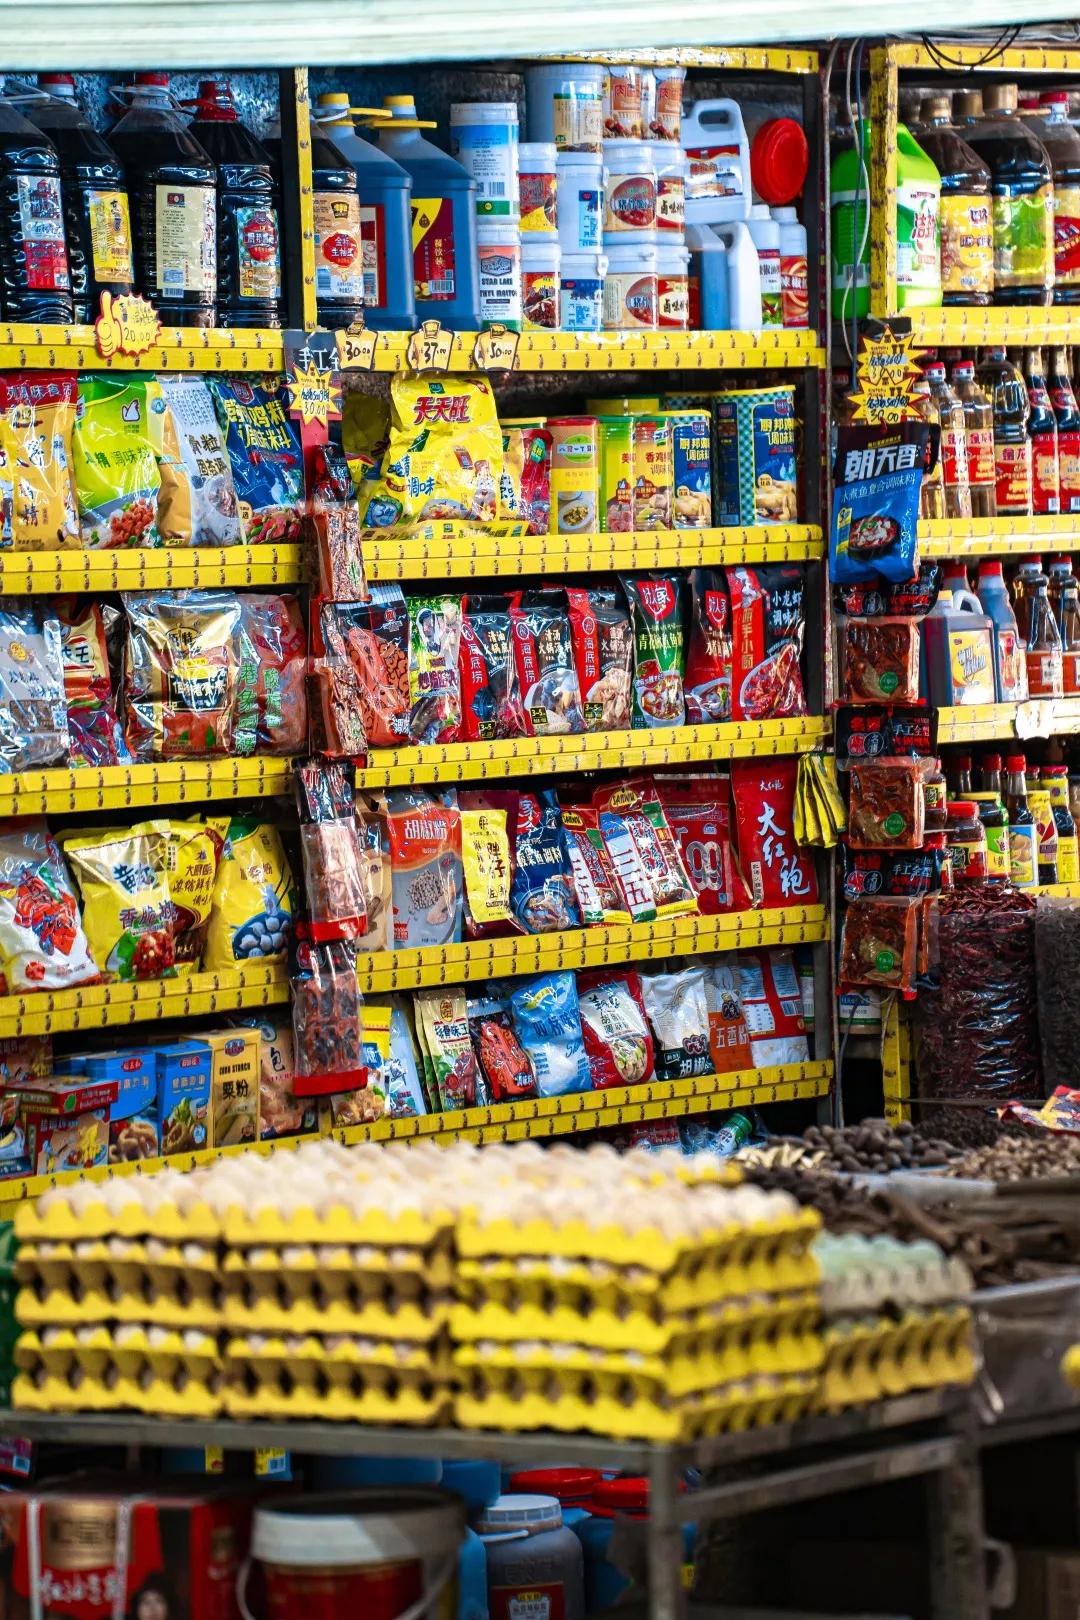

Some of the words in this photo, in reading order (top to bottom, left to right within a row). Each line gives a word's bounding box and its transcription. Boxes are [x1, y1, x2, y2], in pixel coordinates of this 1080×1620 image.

[346, 341, 371, 361] 30.00
[423, 342, 447, 363] 37.00
[489, 341, 513, 359] 50.00
[413, 395, 471, 424] 天天旺
[844, 444, 918, 483] 朝天香
[772, 590, 801, 607] 小龙虾
[467, 643, 484, 684] 海底捞
[520, 642, 537, 683] 海底捞
[583, 637, 597, 678] 海底捞
[759, 781, 784, 792] 大红袍
[404, 820, 447, 840] 胡椒粉
[757, 801, 811, 898] 大红袍
